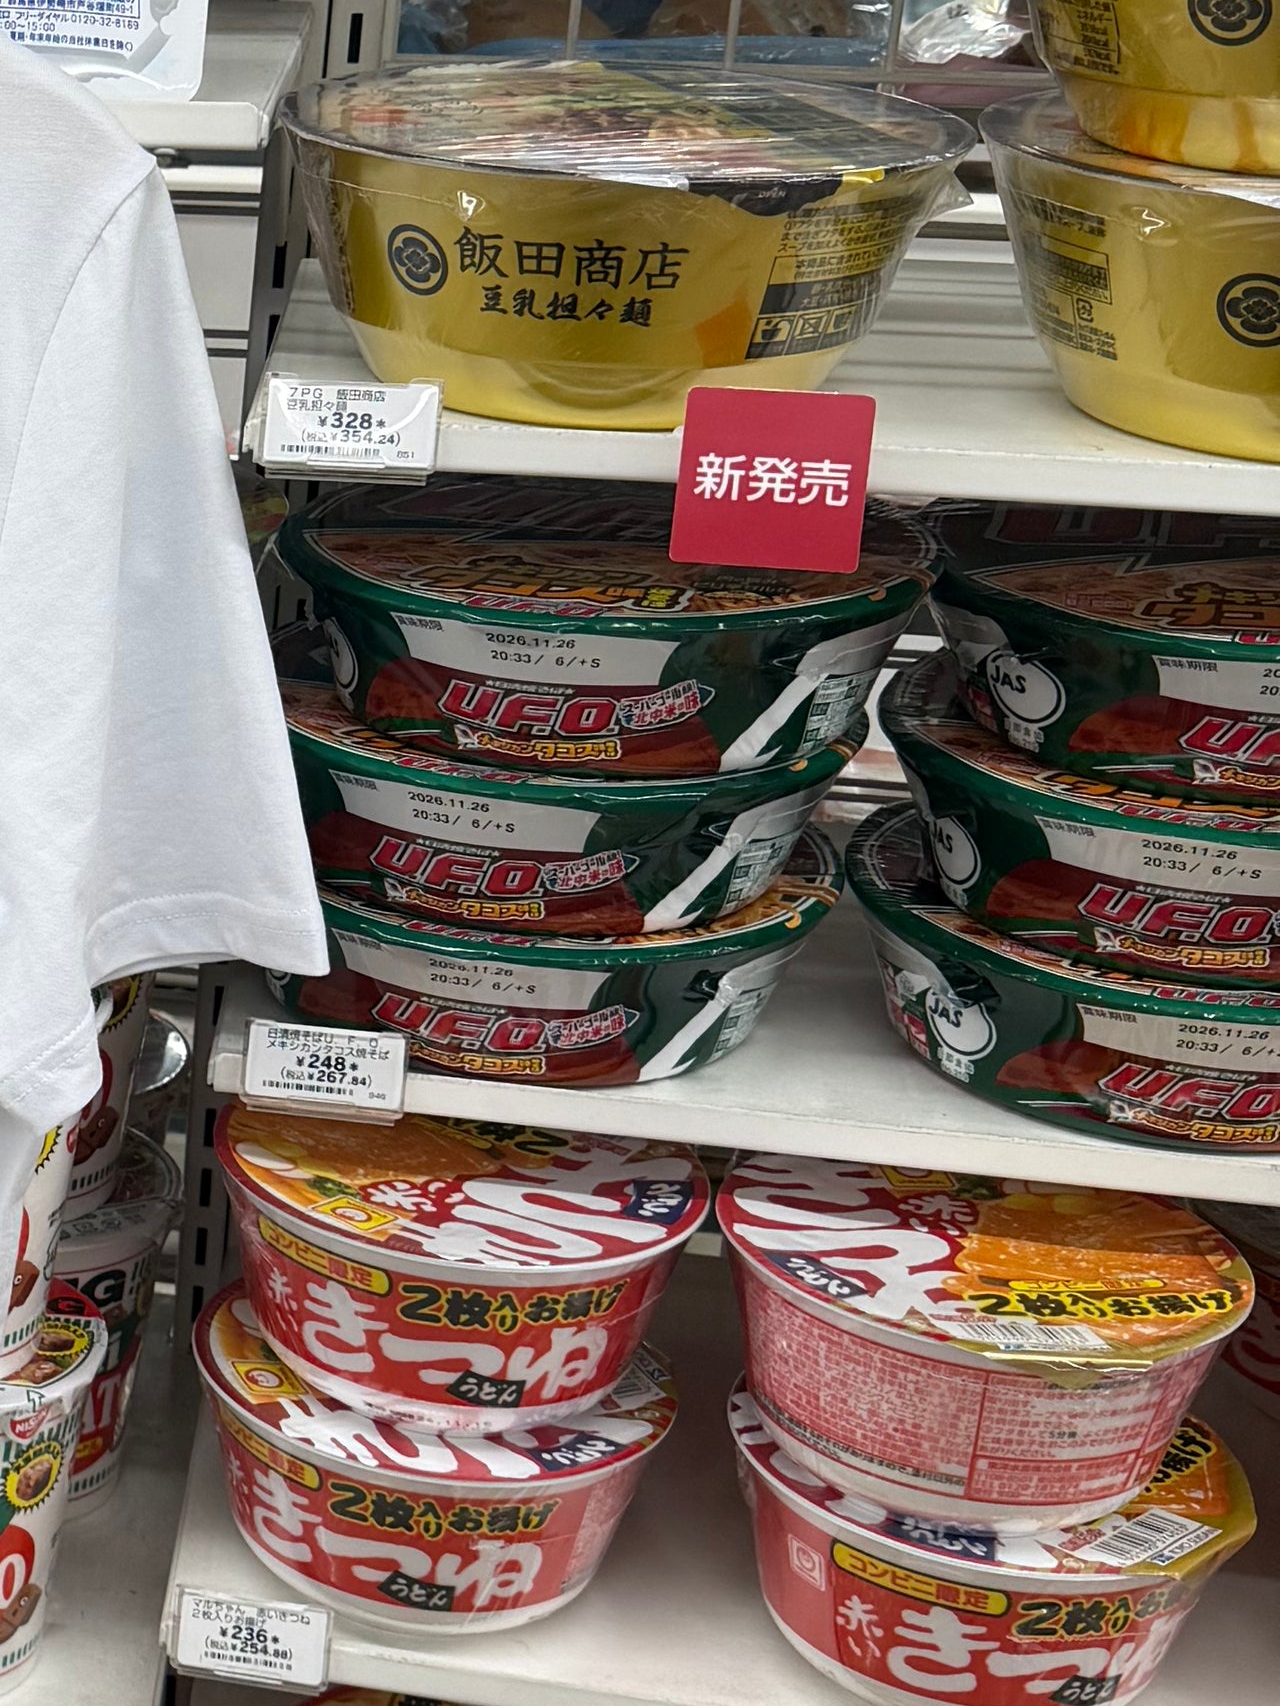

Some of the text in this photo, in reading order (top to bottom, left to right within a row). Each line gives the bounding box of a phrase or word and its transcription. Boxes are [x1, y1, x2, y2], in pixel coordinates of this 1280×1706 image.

[453, 224, 691, 293] 飯田商店
[477, 285, 654, 328] 豆乳担々麺
[287, 399, 348, 412] 豆乳担々麺
[336, 389, 386, 402] 飯田商店
[692, 449, 854, 508] 新発売
[486, 632, 576, 649] 2026.11.26
[408, 791, 490, 813] 2026.11.26
[1141, 839, 1238, 860] 2026.11.26
[266, 1038, 390, 1061] メキシカンタコス焼そば
[1178, 1024, 1270, 1041] 2026.11.26
[265, 1222, 374, 1289] コンビニ限定
[398, 1279, 629, 1337] 2枚入りお揚げ
[972, 1289, 1233, 1324] 2枚入りお揚げ
[301, 1281, 609, 1396] きつね
[457, 1377, 520, 1407] うどん
[329, 1480, 561, 1540] 2枚入りお揚げ
[254, 1471, 543, 1607] きつね
[386, 1576, 452, 1609] うどん
[841, 1550, 992, 1612] コンビニ限定
[836, 1592, 880, 1661] 赤い
